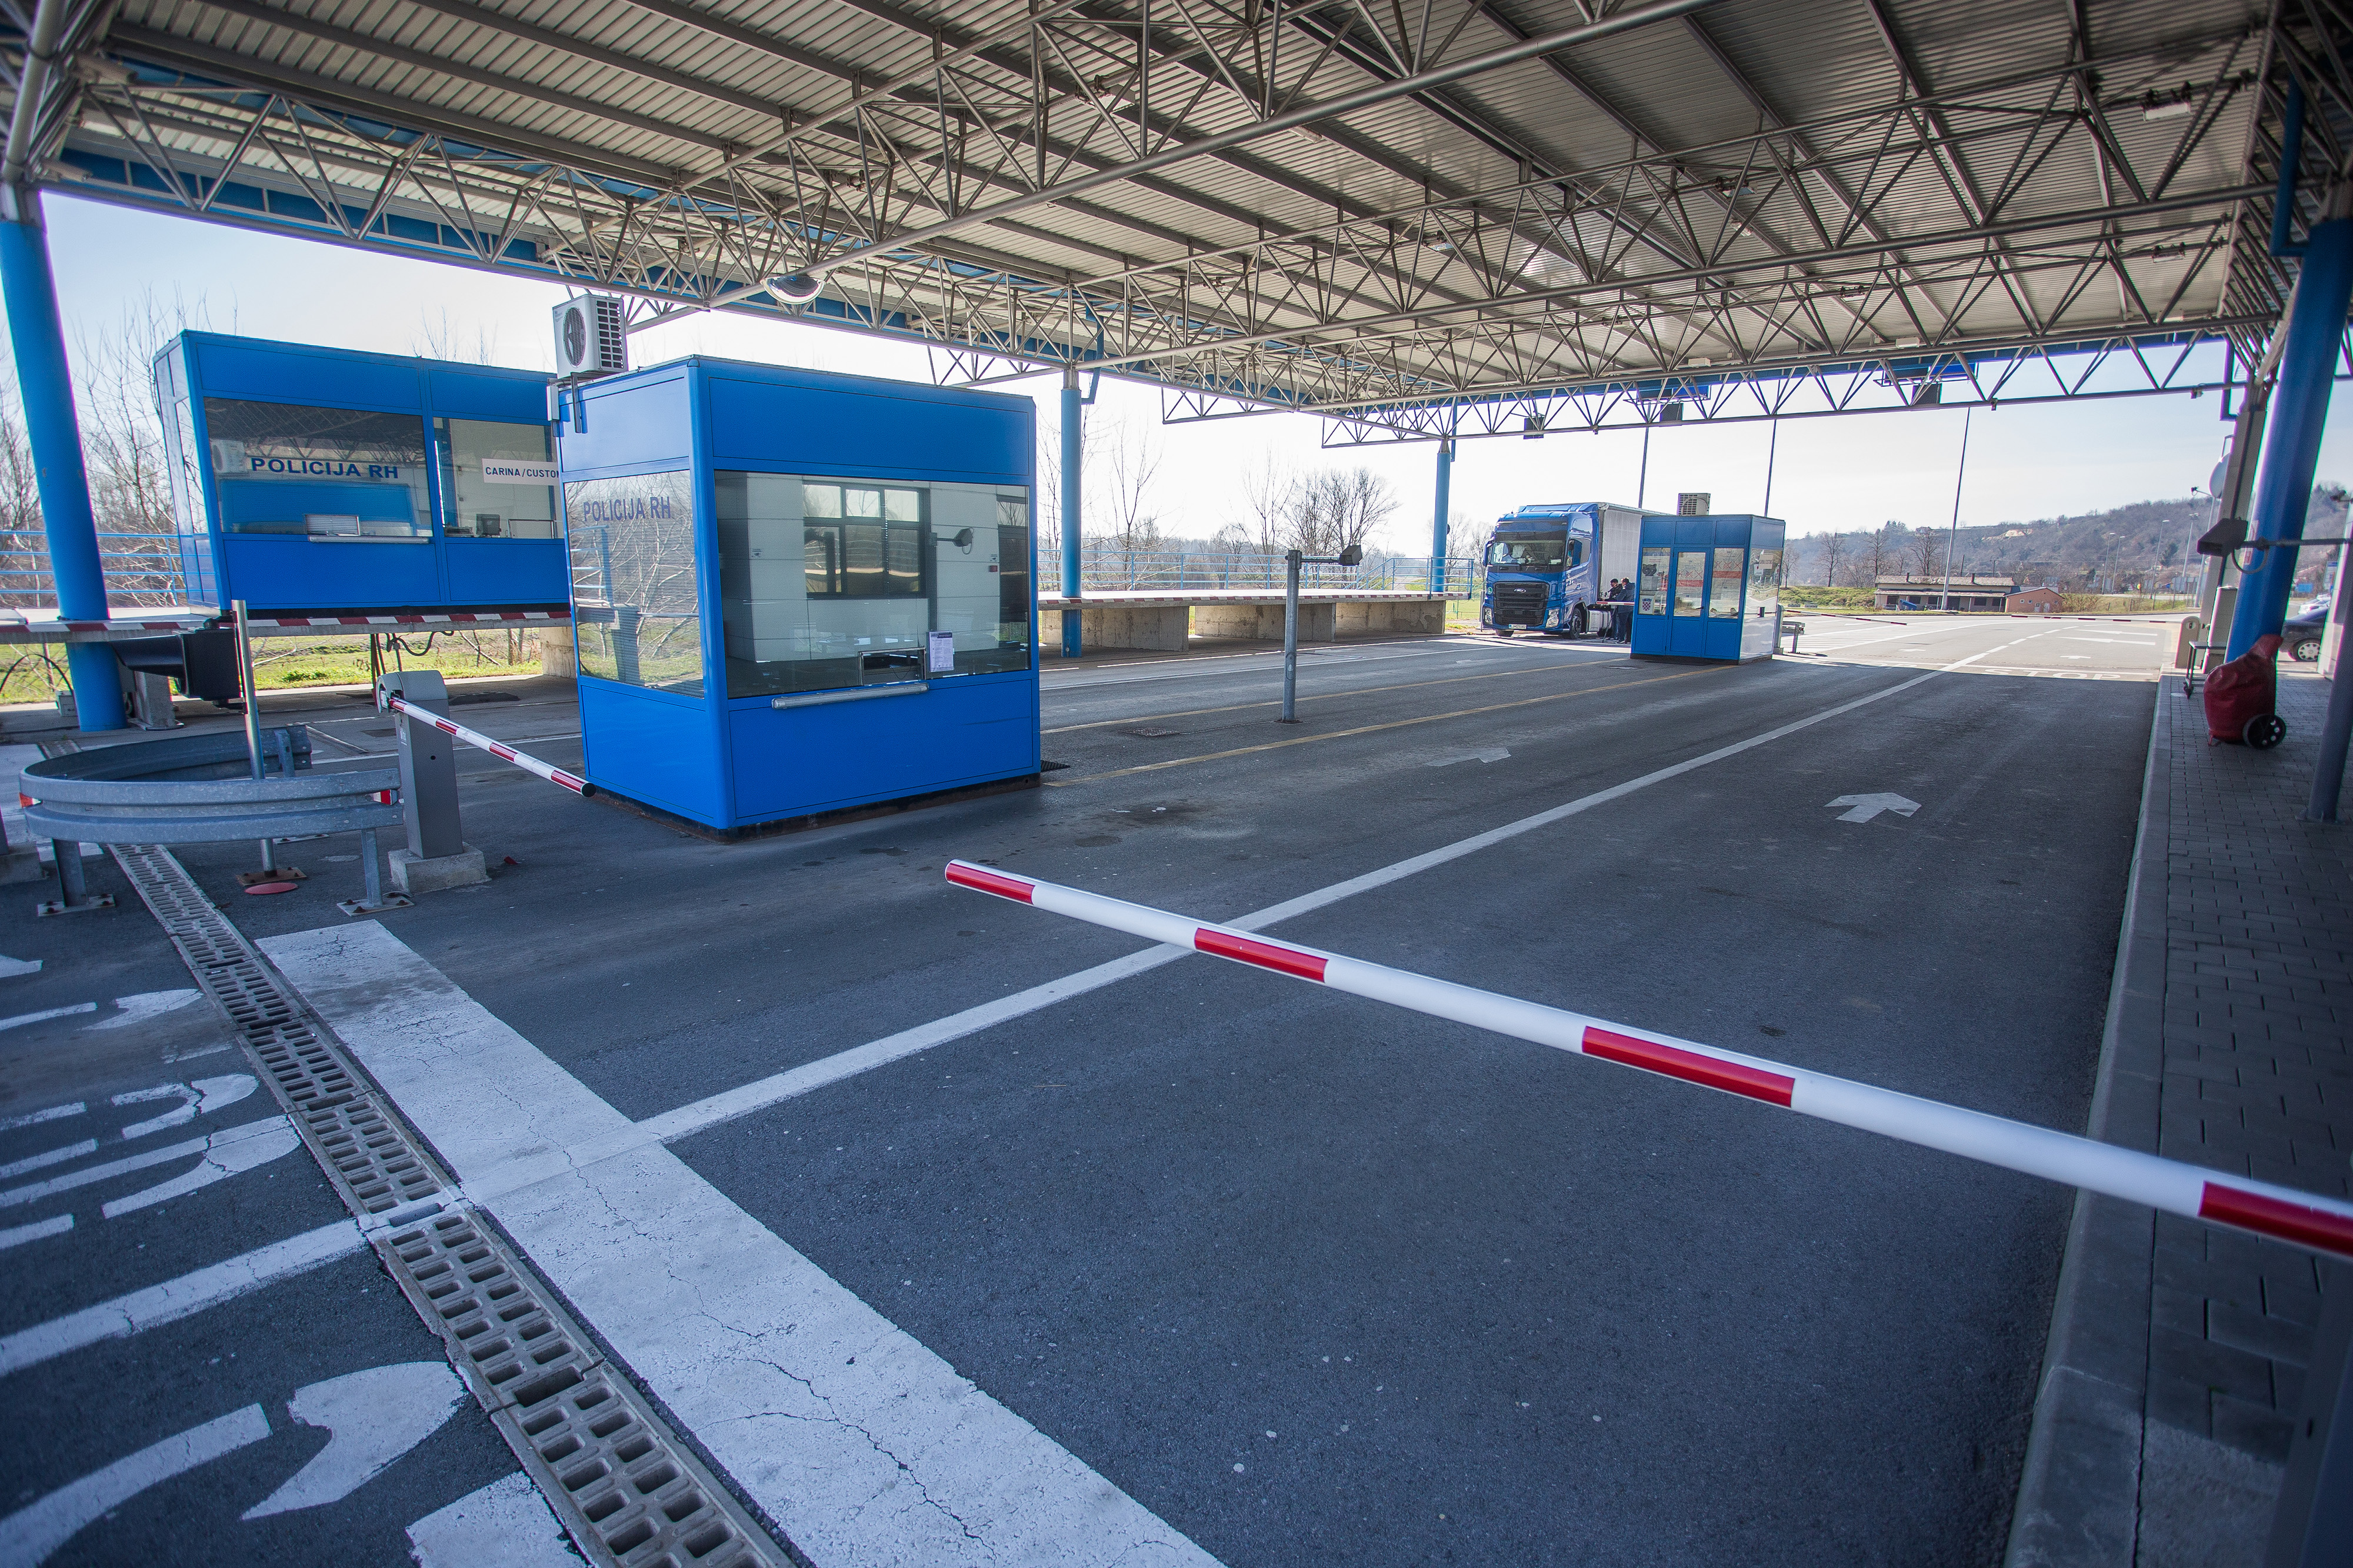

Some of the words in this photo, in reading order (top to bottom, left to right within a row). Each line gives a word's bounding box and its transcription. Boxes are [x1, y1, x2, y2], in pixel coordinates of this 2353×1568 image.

[251, 458, 361, 477] POLICIJA
[368, 464, 399, 479] RH
[485, 466, 559, 478] CARINA/CUSTO
[583, 498, 646, 522] POLICIJA
[650, 496, 671, 519] RH
[1981, 668, 2122, 680] STOP
